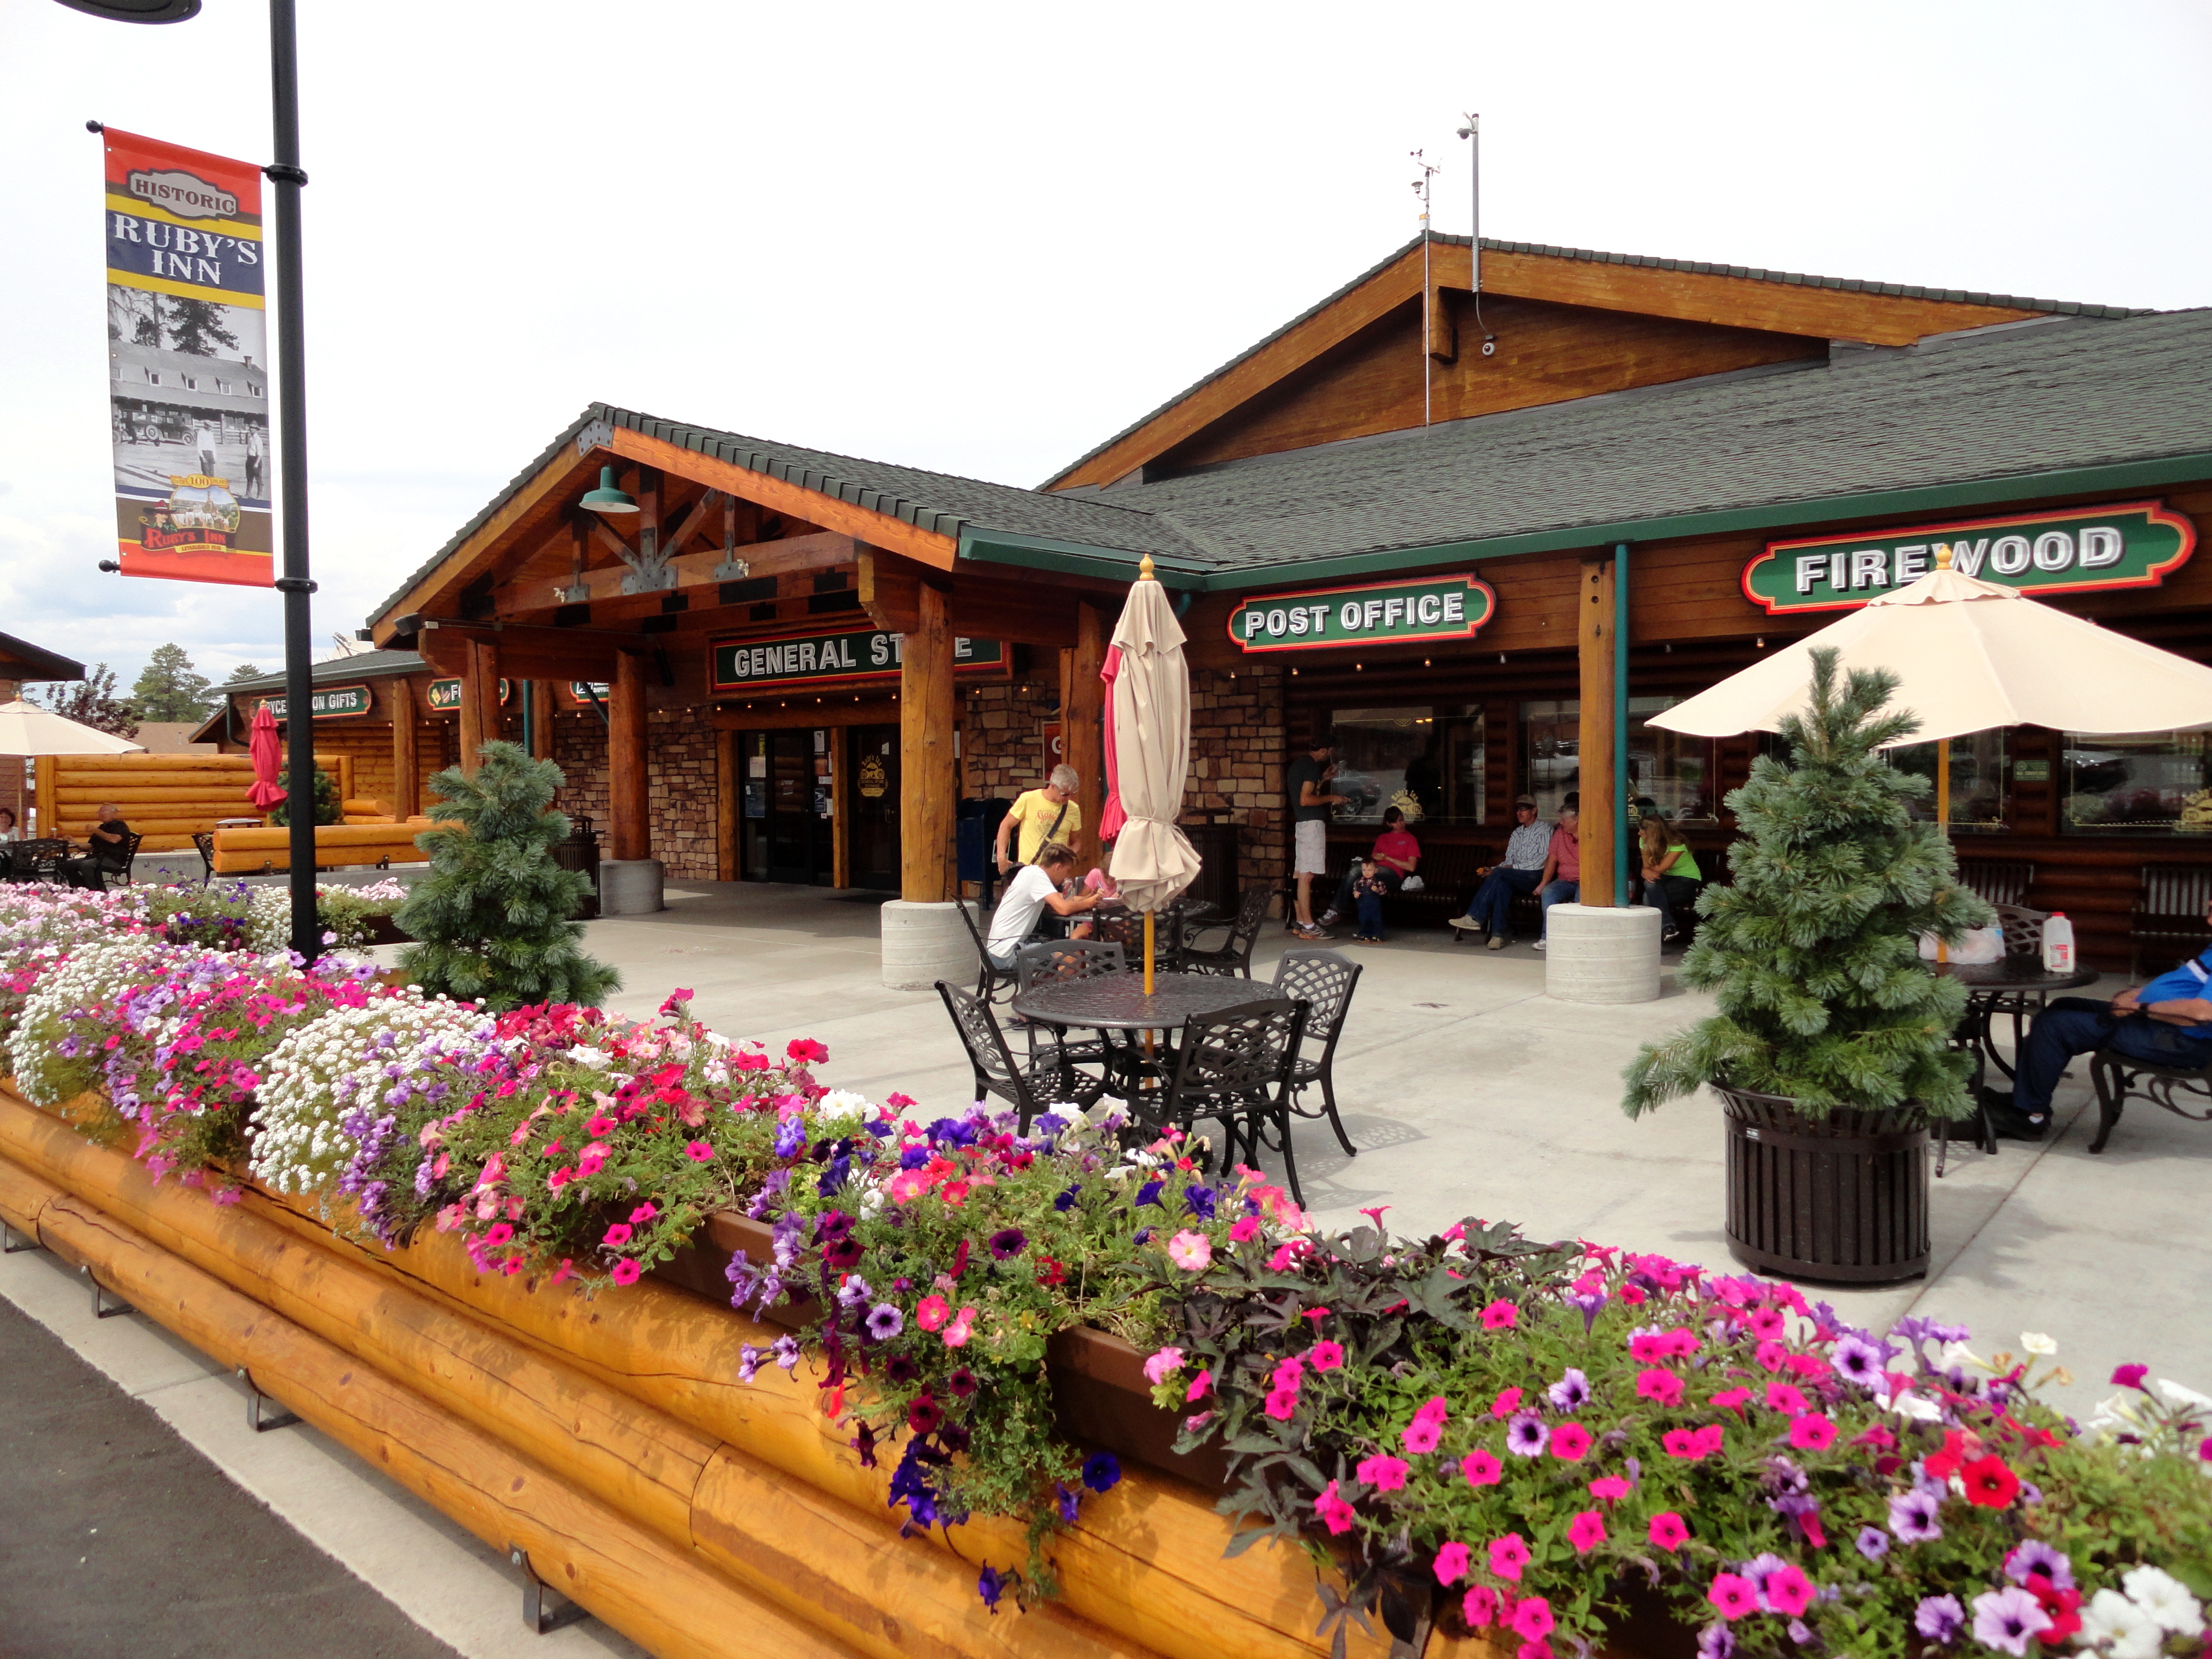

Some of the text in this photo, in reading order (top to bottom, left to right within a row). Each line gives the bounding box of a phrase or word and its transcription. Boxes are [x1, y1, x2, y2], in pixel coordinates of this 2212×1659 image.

[136, 179, 235, 213] HISTORIC
[114, 213, 258, 264] RUBY'S
[152, 250, 222, 285] INN
[190, 477, 209, 486] 100
[1796, 527, 2123, 592] FIREWOOD
[1245, 592, 1464, 637] POST OFFICE
[735, 633, 972, 677] GENERAL STE
[260, 699, 287, 714] RYCE
[329, 692, 357, 709] GIFTS
